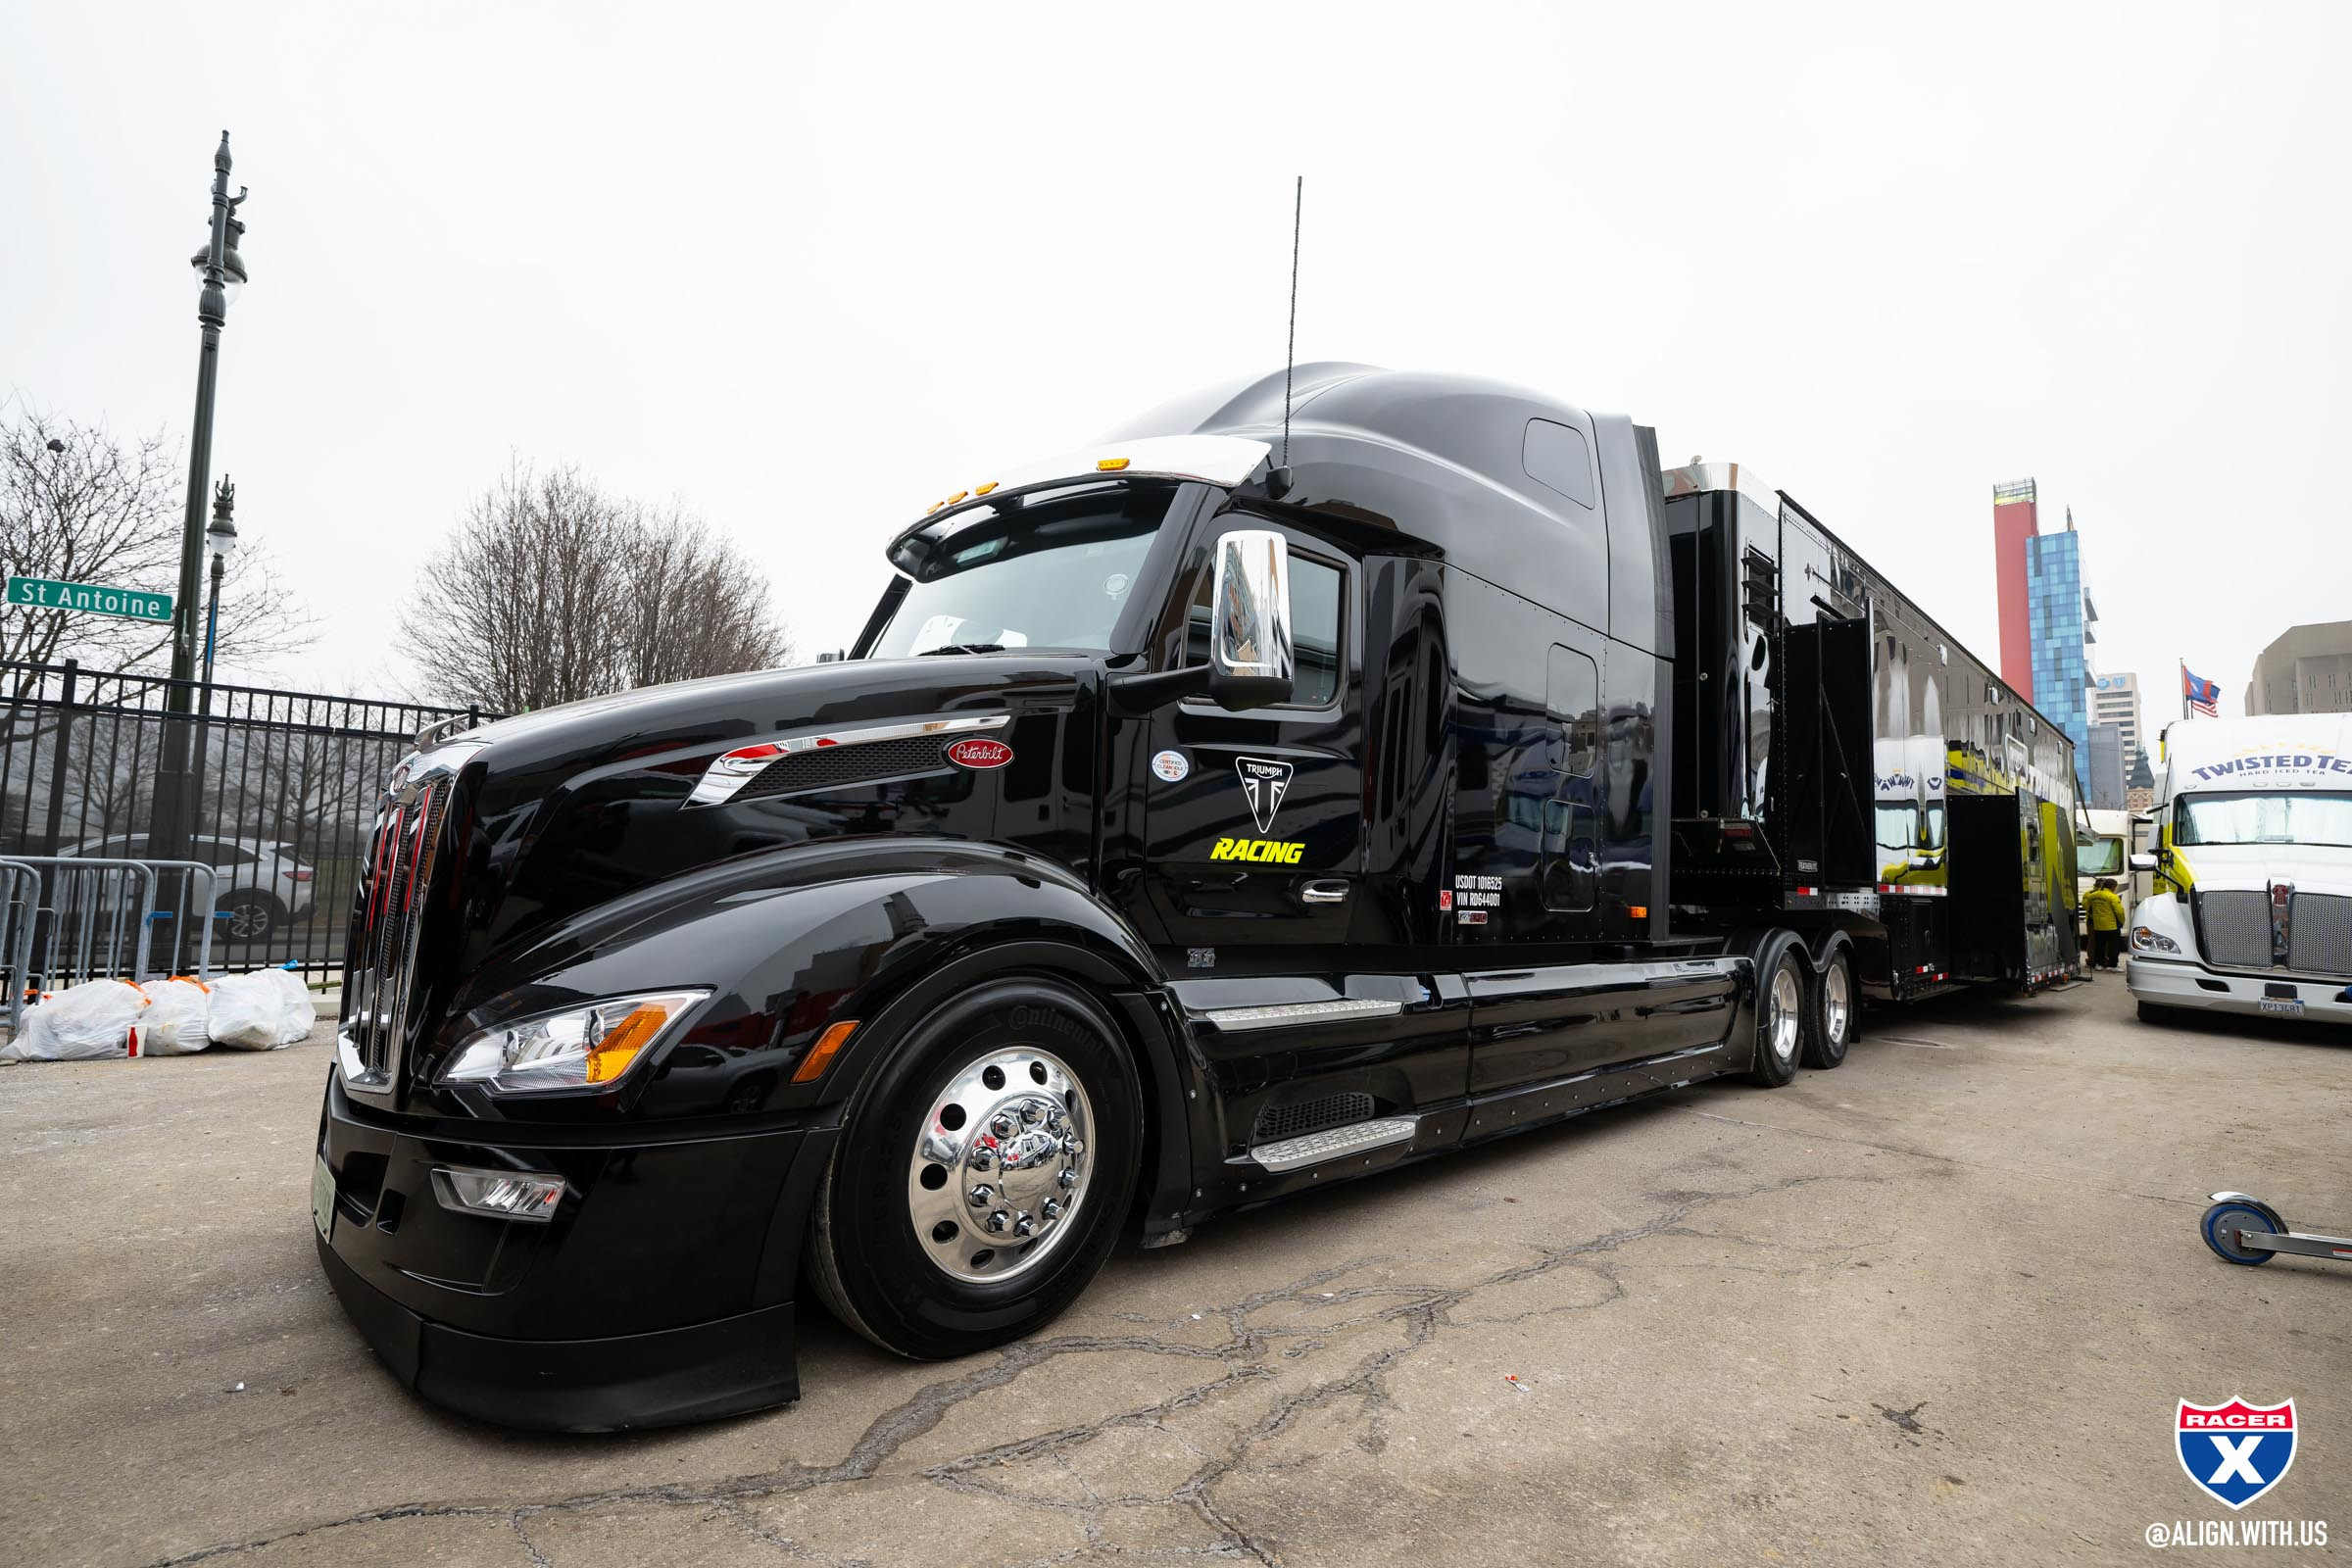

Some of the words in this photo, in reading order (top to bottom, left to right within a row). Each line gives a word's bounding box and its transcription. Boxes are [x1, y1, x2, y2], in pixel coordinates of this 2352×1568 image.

[22, 582, 46, 604] St
[58, 587, 160, 616] Antoine
[956, 744, 1007, 760] Peterbilt
[1246, 762, 1283, 777] TRIUMPH
[2191, 755, 2313, 781] TWISTED
[2318, 755, 2352, 774] TE
[1209, 837, 1306, 864] RACING
[1455, 874, 1477, 889] USDOT
[1477, 875, 1502, 891] 1016525
[1456, 892, 1468, 906] VIN
